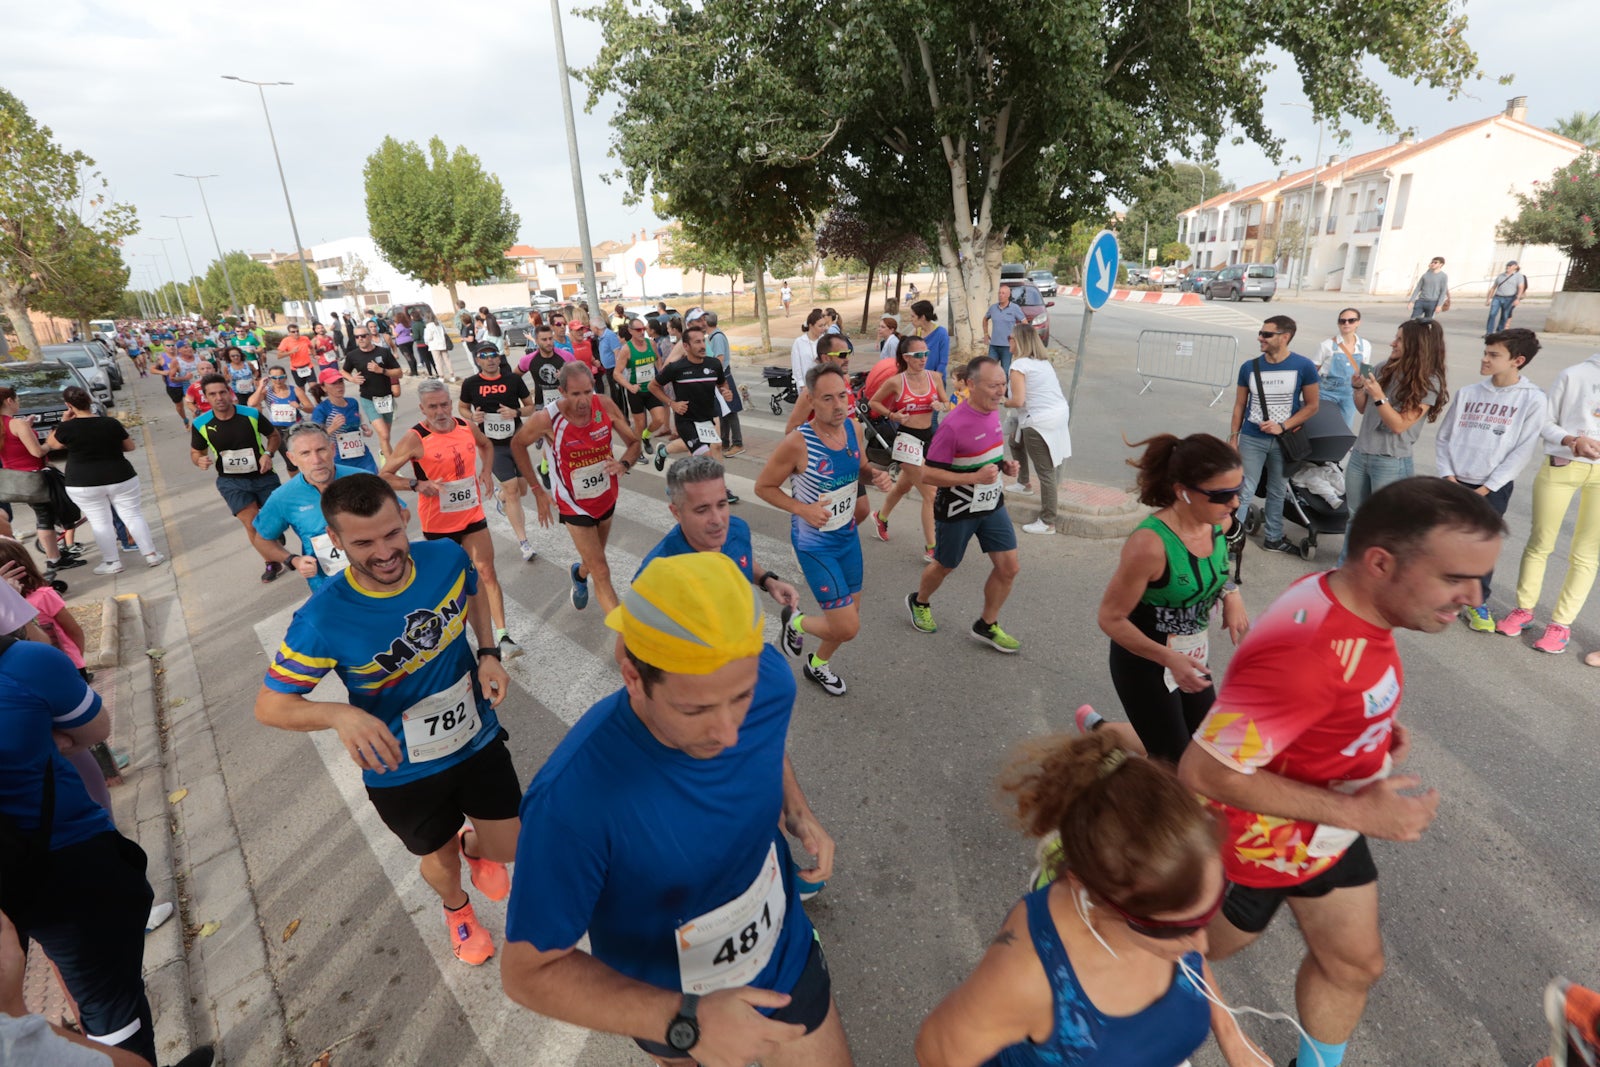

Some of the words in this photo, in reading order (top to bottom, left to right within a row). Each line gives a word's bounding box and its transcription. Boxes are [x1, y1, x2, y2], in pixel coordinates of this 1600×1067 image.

[1464, 402, 1518, 417] VICTORY
[1484, 415, 1512, 425] AROUND
[488, 423, 511, 432] 3058
[896, 442, 920, 456] 2103
[228, 457, 249, 466] 279
[582, 472, 604, 489] 394
[449, 489, 471, 503] 368
[831, 497, 852, 516] 182
[424, 701, 467, 737] 782
[712, 900, 772, 966] 481
